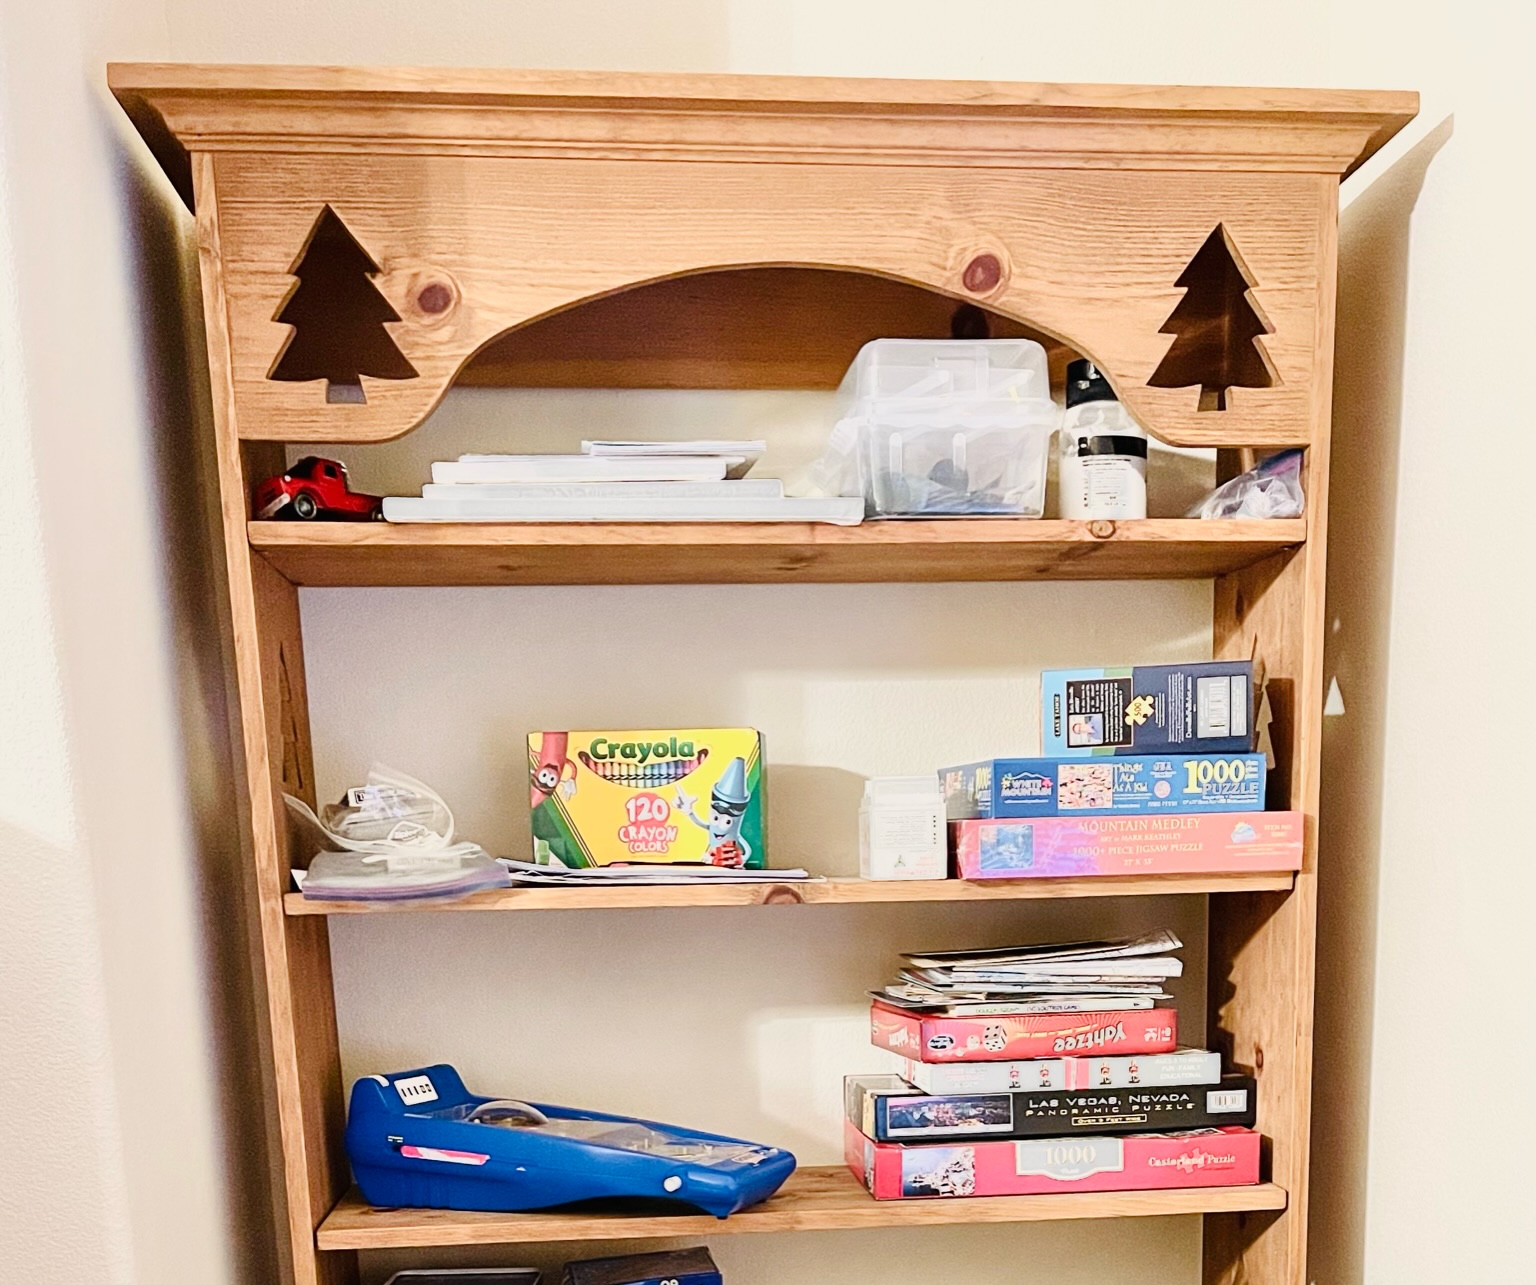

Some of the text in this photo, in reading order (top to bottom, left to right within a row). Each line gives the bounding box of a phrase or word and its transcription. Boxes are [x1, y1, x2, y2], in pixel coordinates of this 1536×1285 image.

[1133, 702, 1142, 717] 500
[590, 737, 694, 763] Crayola
[1183, 759, 1246, 794] 1000
[1202, 782, 1259, 795] PUZZLE
[625, 796, 670, 823] 120
[1078, 817, 1201, 834] MOUNTAIN MEDLEY
[618, 825, 678, 843] CRAYON
[628, 840, 669, 853] COLORS
[1108, 844, 1133, 854] PIECE
[1135, 843, 1168, 854] JIGSAW
[1170, 842, 1203, 852] PUZZLE
[1053, 1021, 1127, 1052] Yahtzee
[1029, 1093, 1190, 1109] LAS VEGAS, NEVADA
[1026, 1103, 1195, 1117] PANORAMIC PUZZLE
[1045, 1145, 1097, 1166] 1000
[1206, 1153, 1236, 1165] Puzzle
